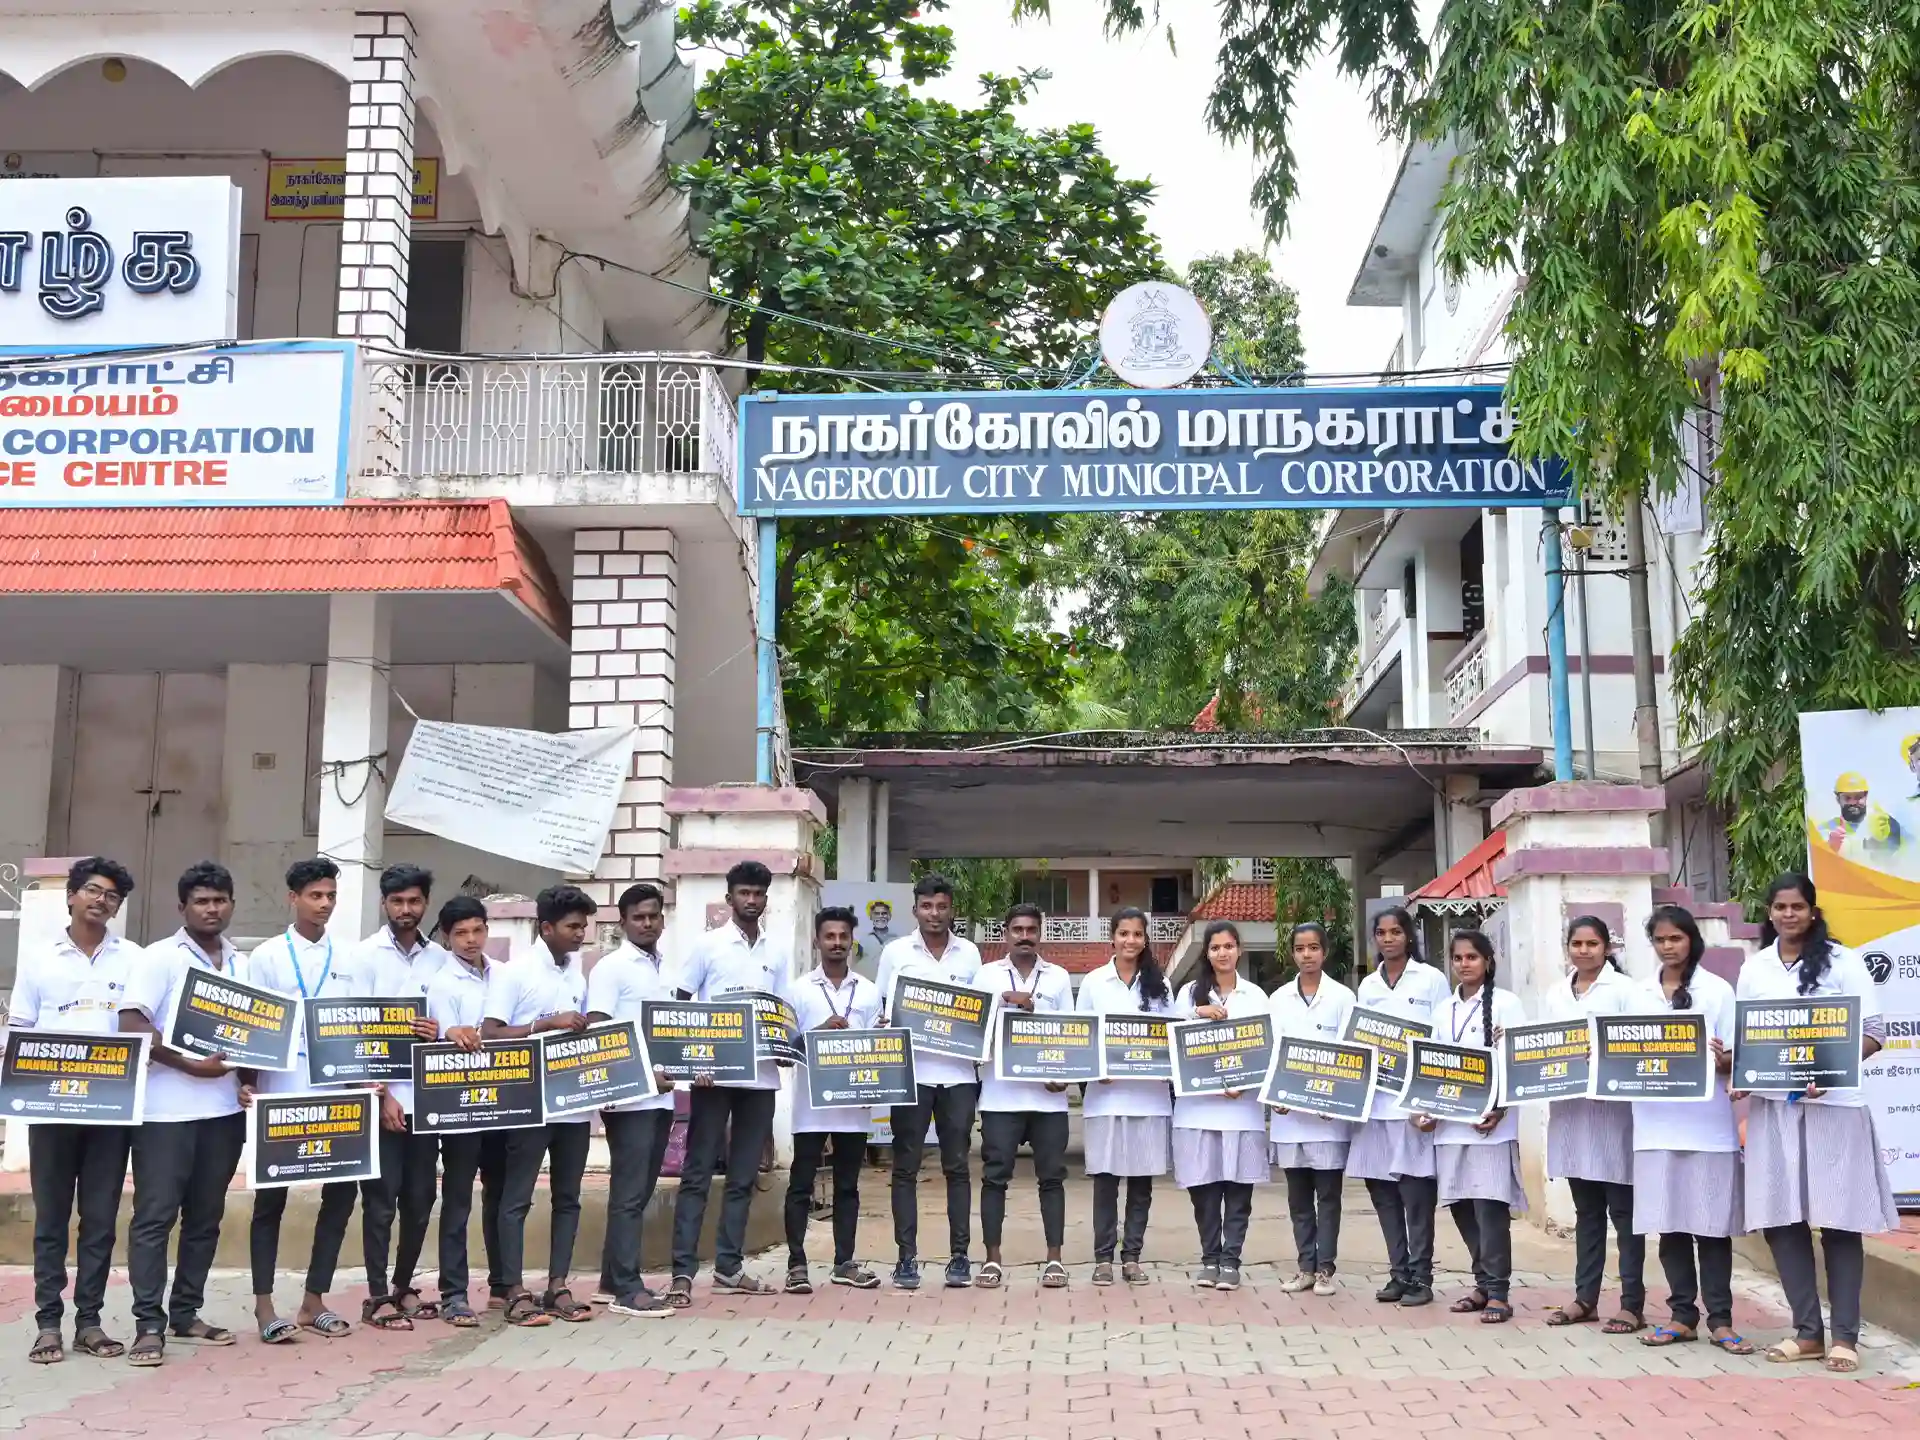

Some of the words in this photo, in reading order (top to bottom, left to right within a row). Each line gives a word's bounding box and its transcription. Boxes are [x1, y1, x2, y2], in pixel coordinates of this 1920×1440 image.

[3, 427, 314, 455] CORPORATION
[760, 398, 1161, 467] நாகர்கோவில்
[63, 460, 228, 487] CENTRE
[753, 465, 951, 501] NAGERCOIL
[963, 464, 1048, 498] CITY
[1061, 461, 1263, 497] MUNICIPAL
[1281, 458, 1546, 494] CORPORATION
[193, 980, 252, 1011] MISSION
[251, 999, 285, 1019] ZERO
[903, 985, 954, 1006] MISSION
[953, 995, 982, 1012] ZERO
[318, 1007, 380, 1023] MISSION
[652, 1011, 708, 1027] MISSION
[710, 1013, 743, 1026] ZERO
[1746, 1009, 1808, 1027] MISSION
[1811, 1008, 1848, 1025] ZERO
[1012, 1020, 1061, 1035] MISSION
[1062, 1024, 1090, 1036] ZERO
[1184, 1028, 1234, 1046] MISSION
[1236, 1023, 1264, 1039] ZERO
[1356, 1016, 1401, 1040] MISSION
[1606, 1025, 1662, 1040] MISSION
[1664, 1024, 1696, 1040] ZERO
[19, 1042, 88, 1060] MISSION
[89, 1046, 128, 1062] ZERO
[546, 1037, 598, 1060] MISSION
[598, 1032, 628, 1049] ZERO
[817, 1039, 872, 1054] MISSION
[875, 1038, 903, 1052] ZERO
[1514, 1031, 1564, 1050] MISSION
[425, 1052, 491, 1071] MISSION
[493, 1050, 530, 1067] ZERO
[1287, 1046, 1336, 1064] MISSION
[1336, 1053, 1363, 1069] ZERO
[1421, 1050, 1461, 1069] MISSION
[1462, 1056, 1485, 1073] ZERO
[269, 1105, 328, 1124] MISSION
[329, 1104, 361, 1120] ZERO
